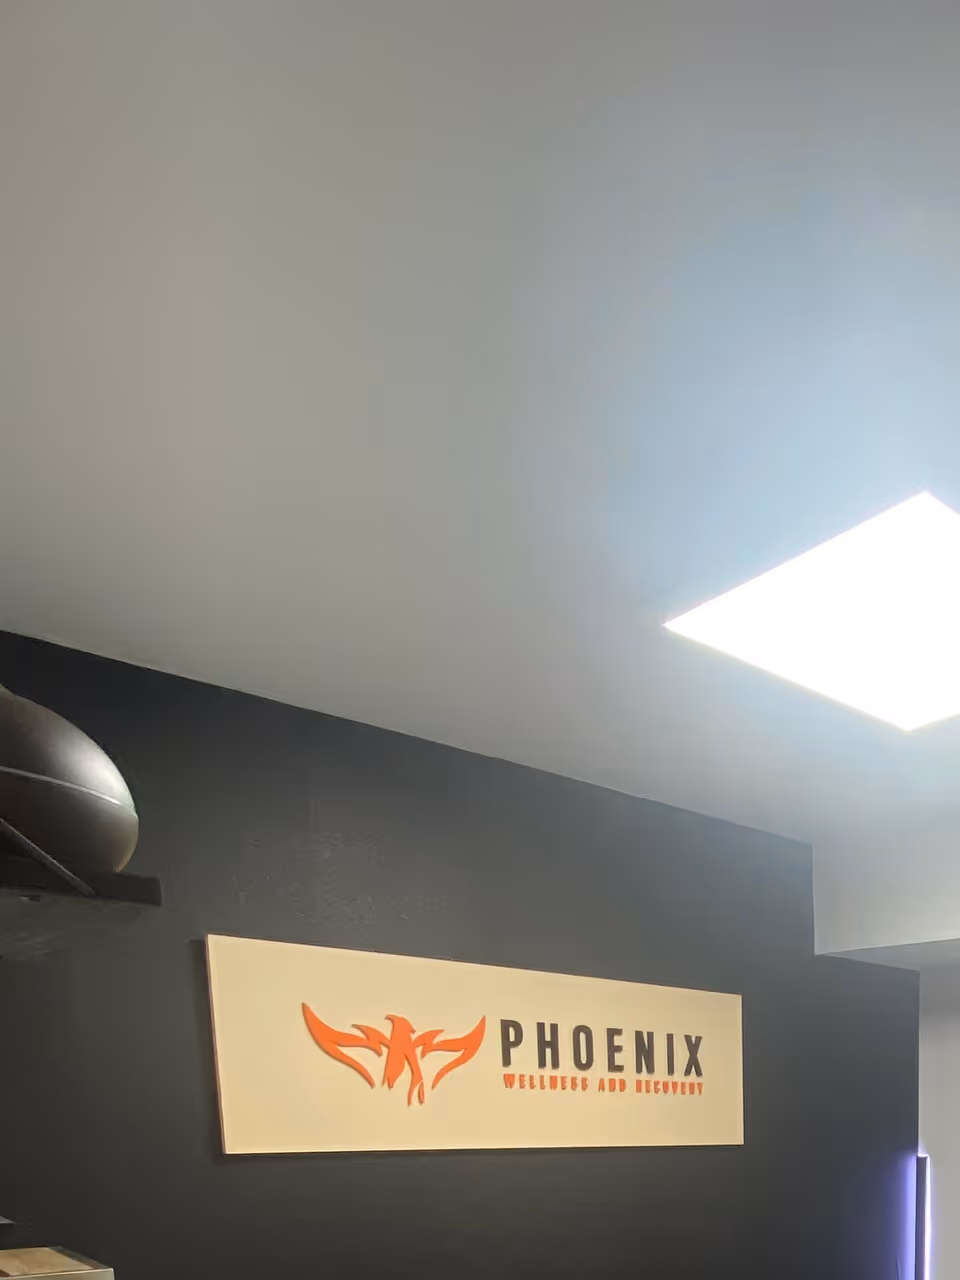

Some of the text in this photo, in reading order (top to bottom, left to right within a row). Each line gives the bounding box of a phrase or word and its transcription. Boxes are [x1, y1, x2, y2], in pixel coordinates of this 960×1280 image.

[500, 1018, 703, 1077] PHOENIX
[503, 1073, 704, 1096] WELLNESS AND RECOVERY
